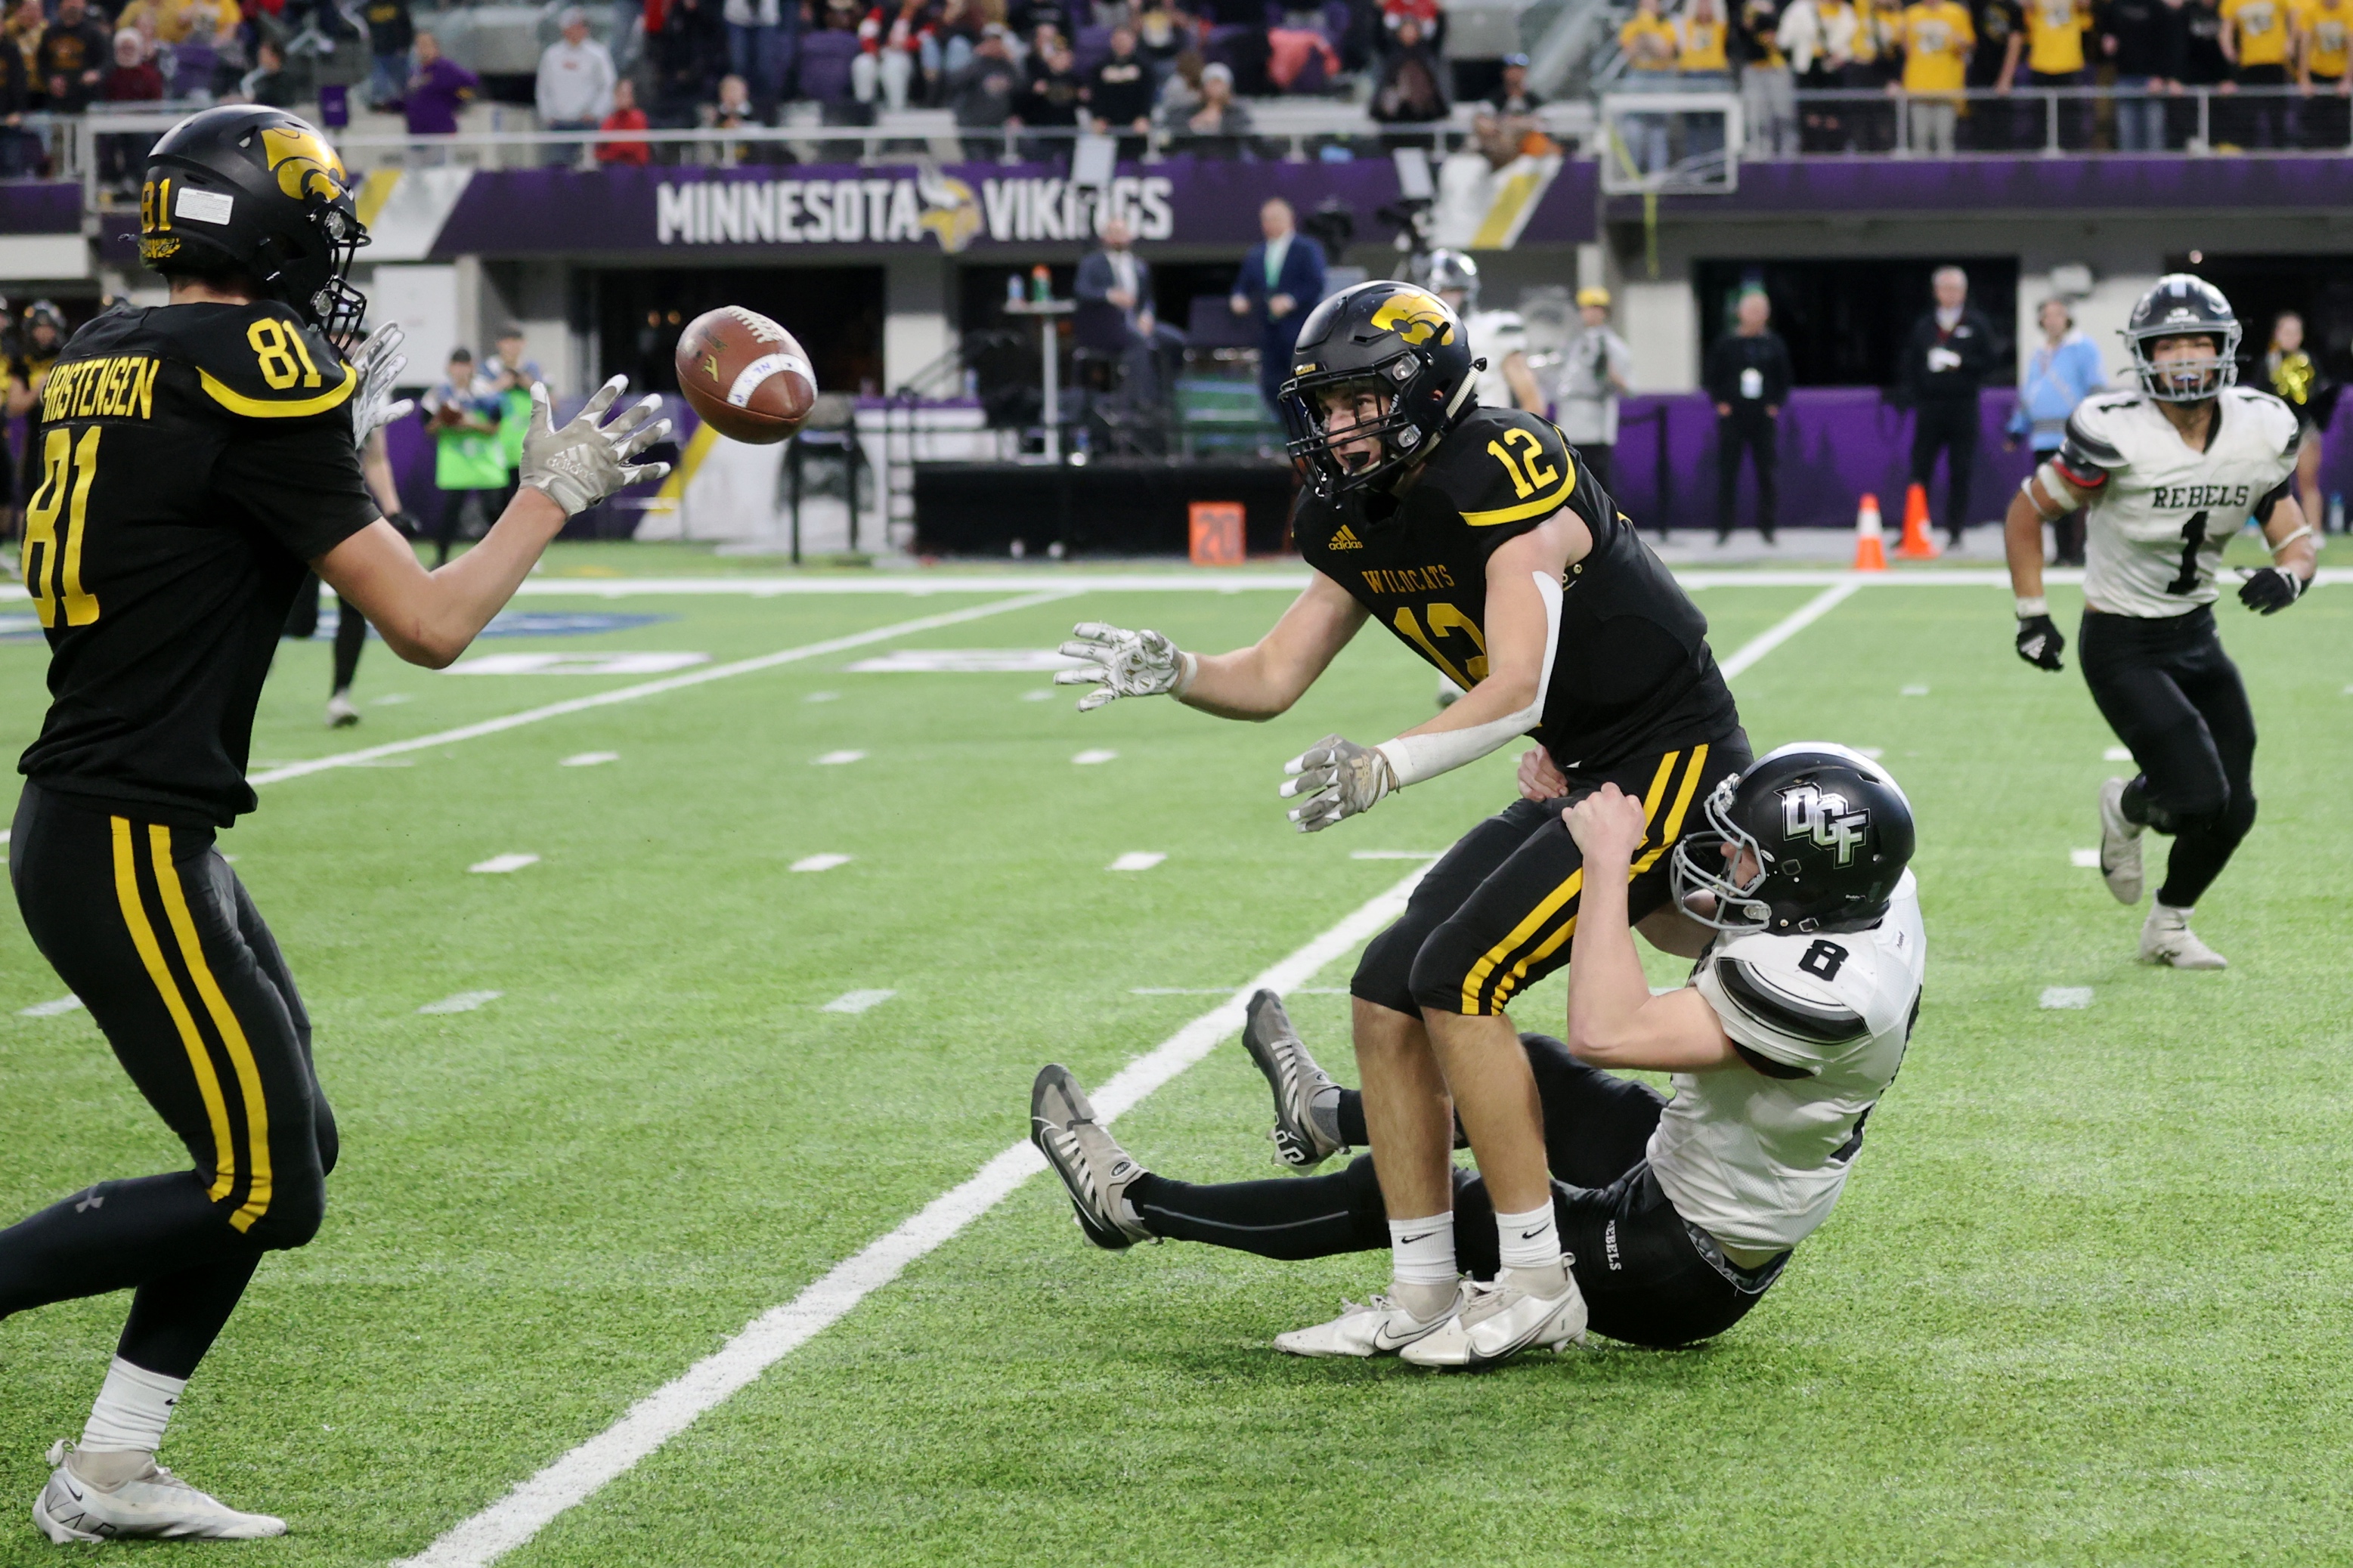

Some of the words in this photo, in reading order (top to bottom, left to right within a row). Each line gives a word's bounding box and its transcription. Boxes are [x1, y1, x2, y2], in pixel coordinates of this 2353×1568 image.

[141, 178, 172, 233] 81
[657, 180, 923, 244] MINNESOTA
[246, 317, 321, 390] 81
[1487, 428, 1559, 499] 12
[21, 425, 102, 628] 81
[2153, 485, 2249, 509] REBELS
[1328, 540, 1364, 551] adidas
[2166, 510, 2209, 594] 1
[1361, 564, 1455, 593] WILDCATS
[1783, 786, 1867, 864] DGF
[1797, 939, 1850, 982] 8
